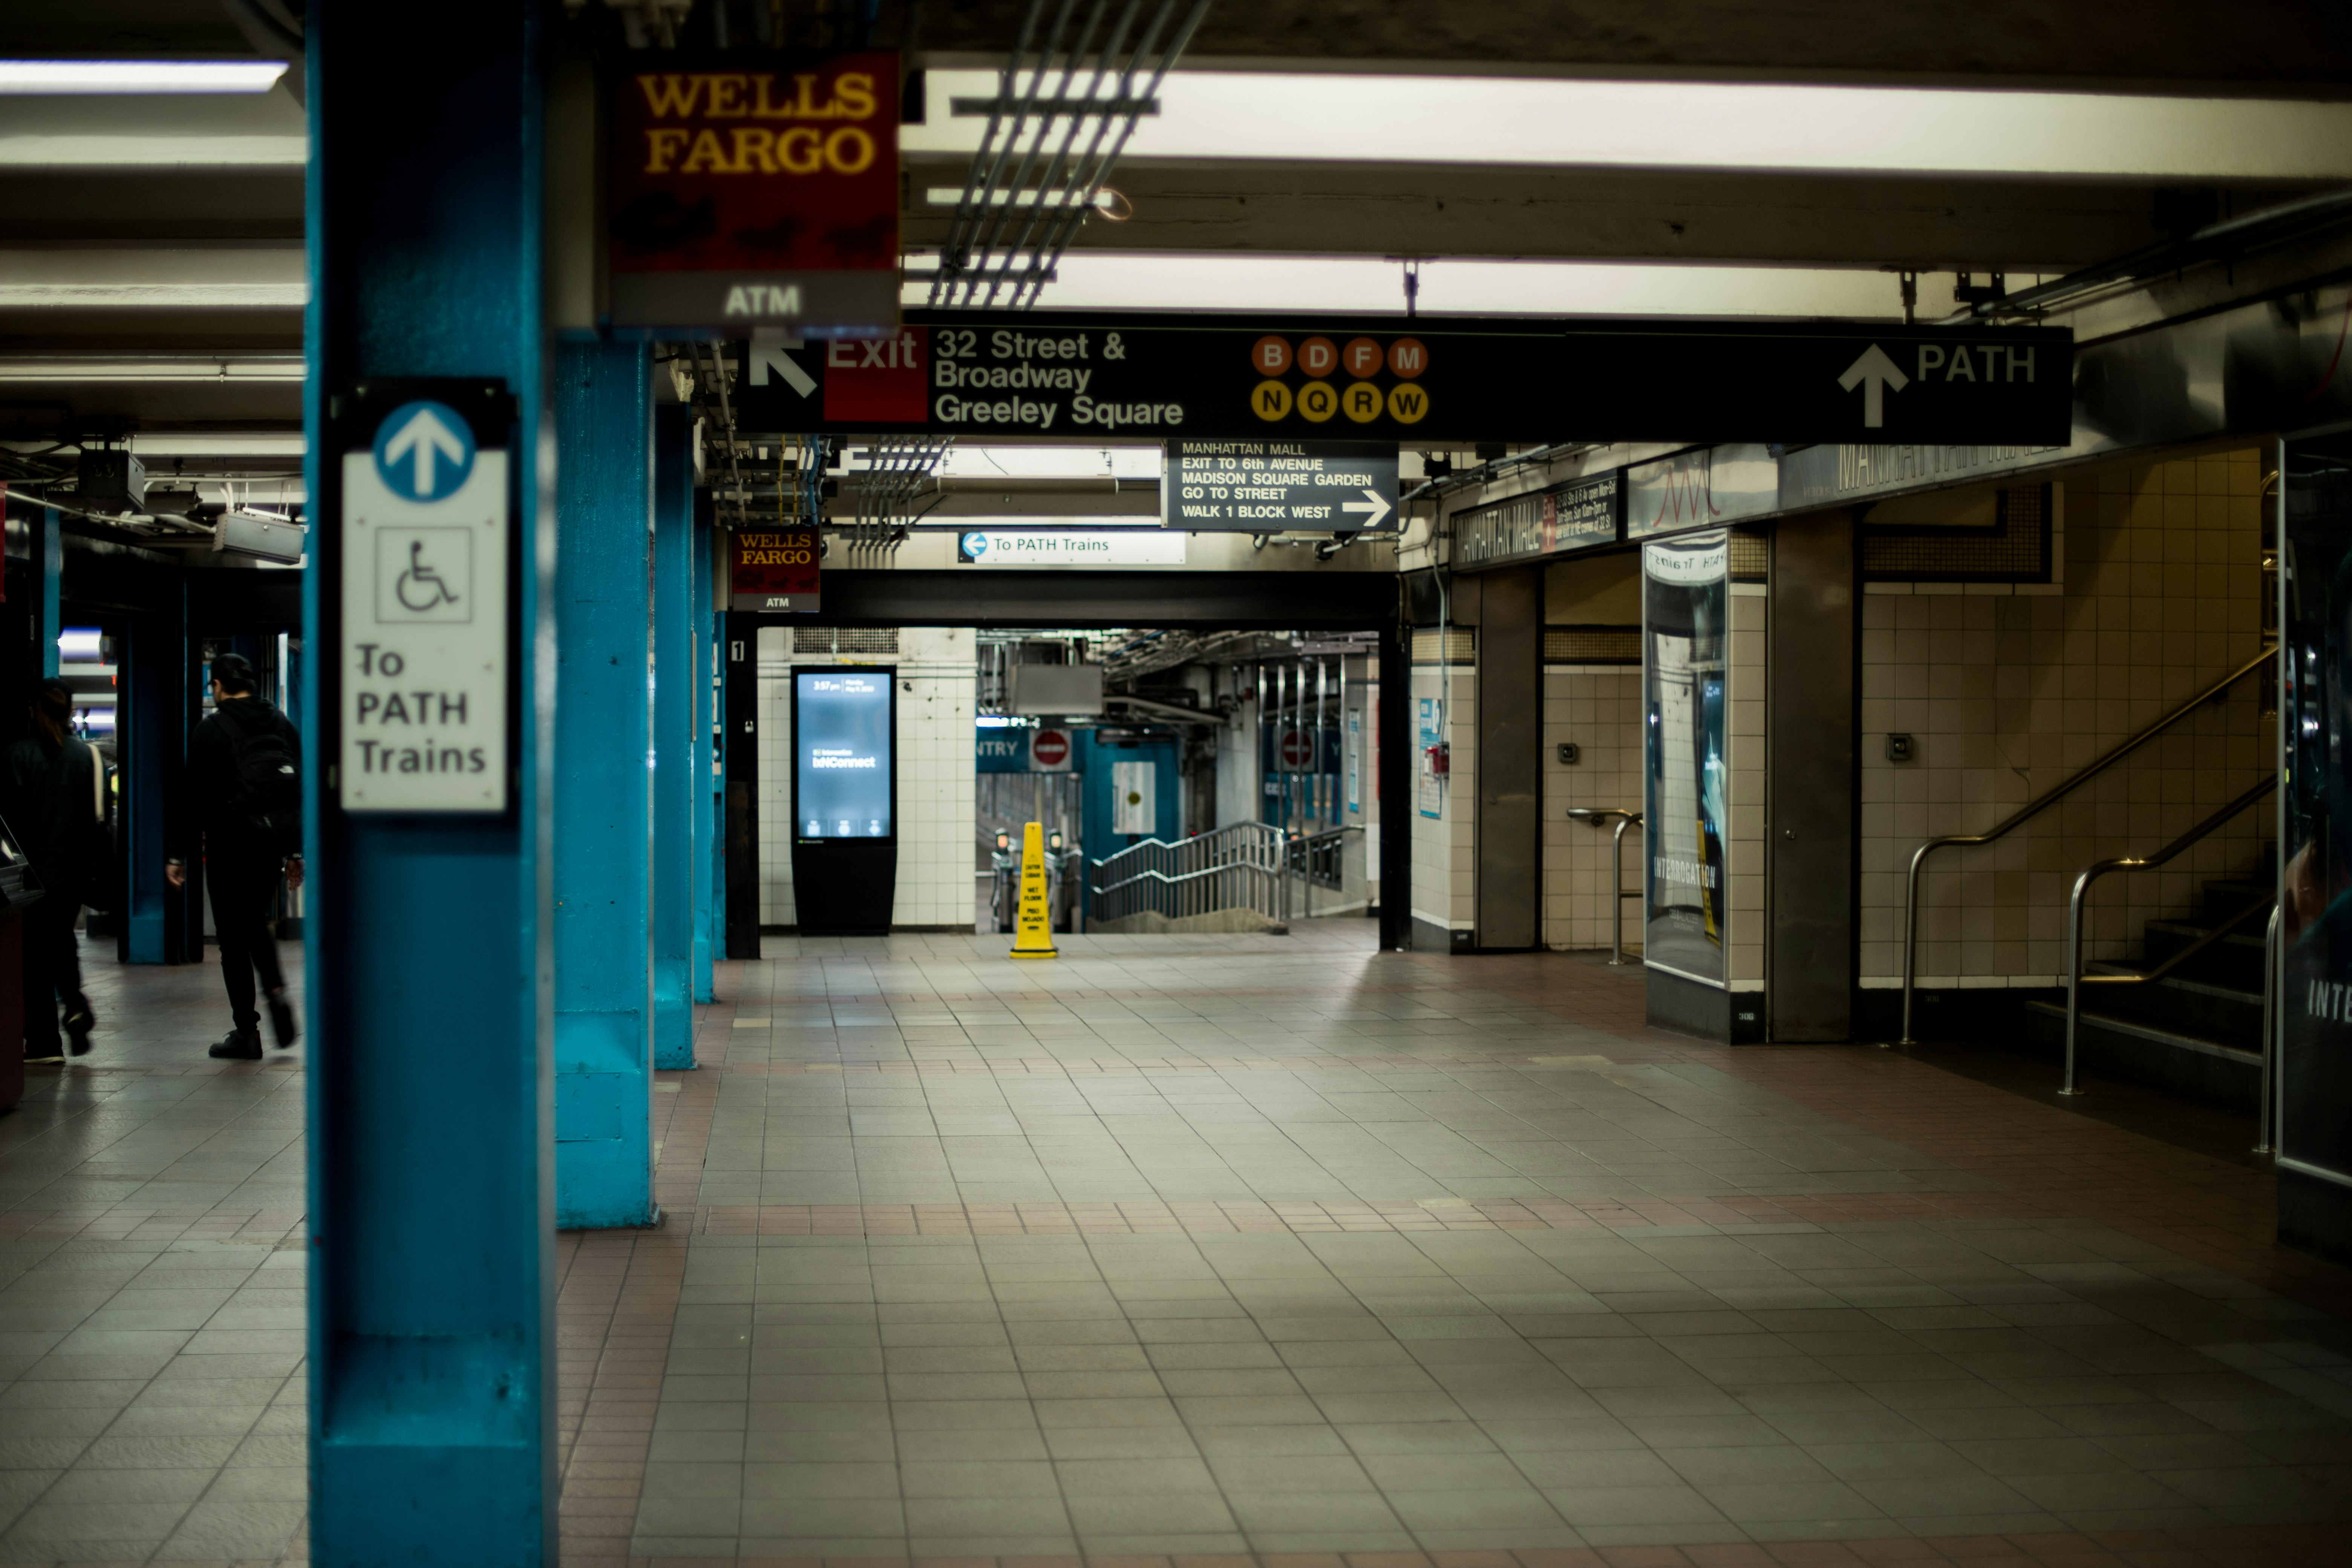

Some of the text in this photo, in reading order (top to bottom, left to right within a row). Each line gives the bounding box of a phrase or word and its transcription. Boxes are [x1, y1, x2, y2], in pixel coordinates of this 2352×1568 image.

[638, 72, 877, 120] WELLS
[643, 127, 874, 174] FARGO
[724, 286, 801, 314] ATM
[828, 332, 917, 368] Exit
[935, 330, 1126, 360] 32 Street &
[1264, 345, 1419, 369] B D F M
[935, 360, 1091, 394] Broadway
[1919, 345, 2035, 382] PATH
[935, 395, 1183, 429] Greeley Square
[1263, 390, 1421, 415] N Q R W
[1182, 443, 1305, 455] MANHATTAN MALL
[1182, 458, 1323, 471] EXIT TO 6th AVENUE
[1182, 472, 1371, 486] MADISON SQUARE GARDEN
[1182, 487, 1287, 500] GO TO STREET
[1182, 505, 1331, 518] WALK 1 BLOCK WEST
[739, 534, 811, 547] WELLS
[994, 538, 1109, 551] To PATH Trains
[1456, 501, 1539, 563] MANHATTAN MALL
[741, 550, 811, 564] FARGO
[766, 598, 789, 607] ATM
[355, 643, 404, 677] To
[358, 692, 468, 725] PATH
[355, 739, 485, 773] Trains
[1654, 856, 1715, 889] INTERROGATION
